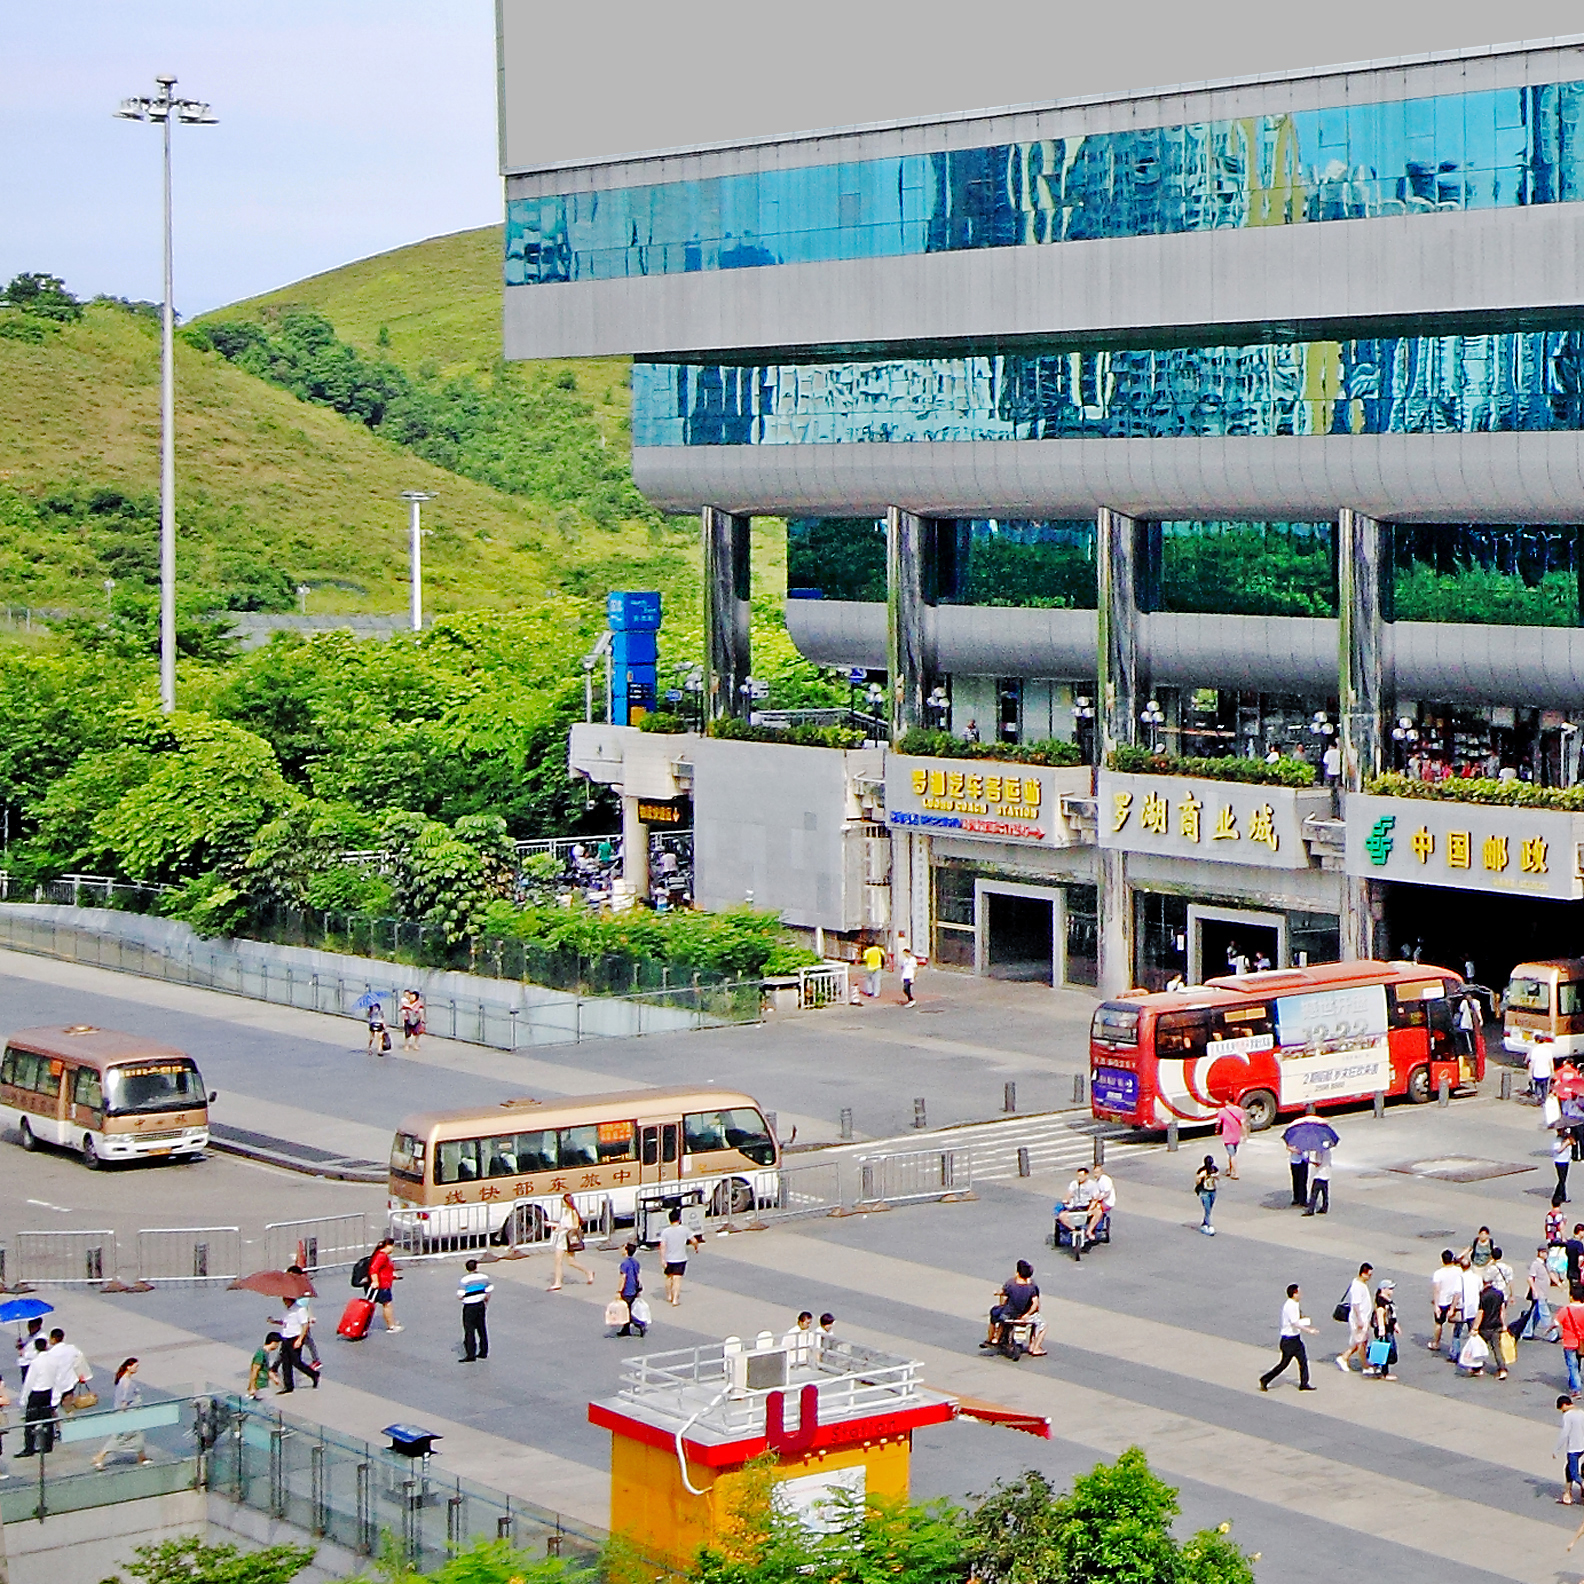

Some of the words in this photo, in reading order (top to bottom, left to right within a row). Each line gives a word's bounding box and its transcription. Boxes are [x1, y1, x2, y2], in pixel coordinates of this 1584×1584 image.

[910, 768, 1041, 806] 罗湖汽车客运站
[922, 798, 955, 812] LUOHU
[956, 802, 989, 815] COACH
[995, 805, 1039, 819] STATION
[1111, 790, 1279, 852] 罗湖商业城
[1411, 825, 1549, 873] 中国邮政
